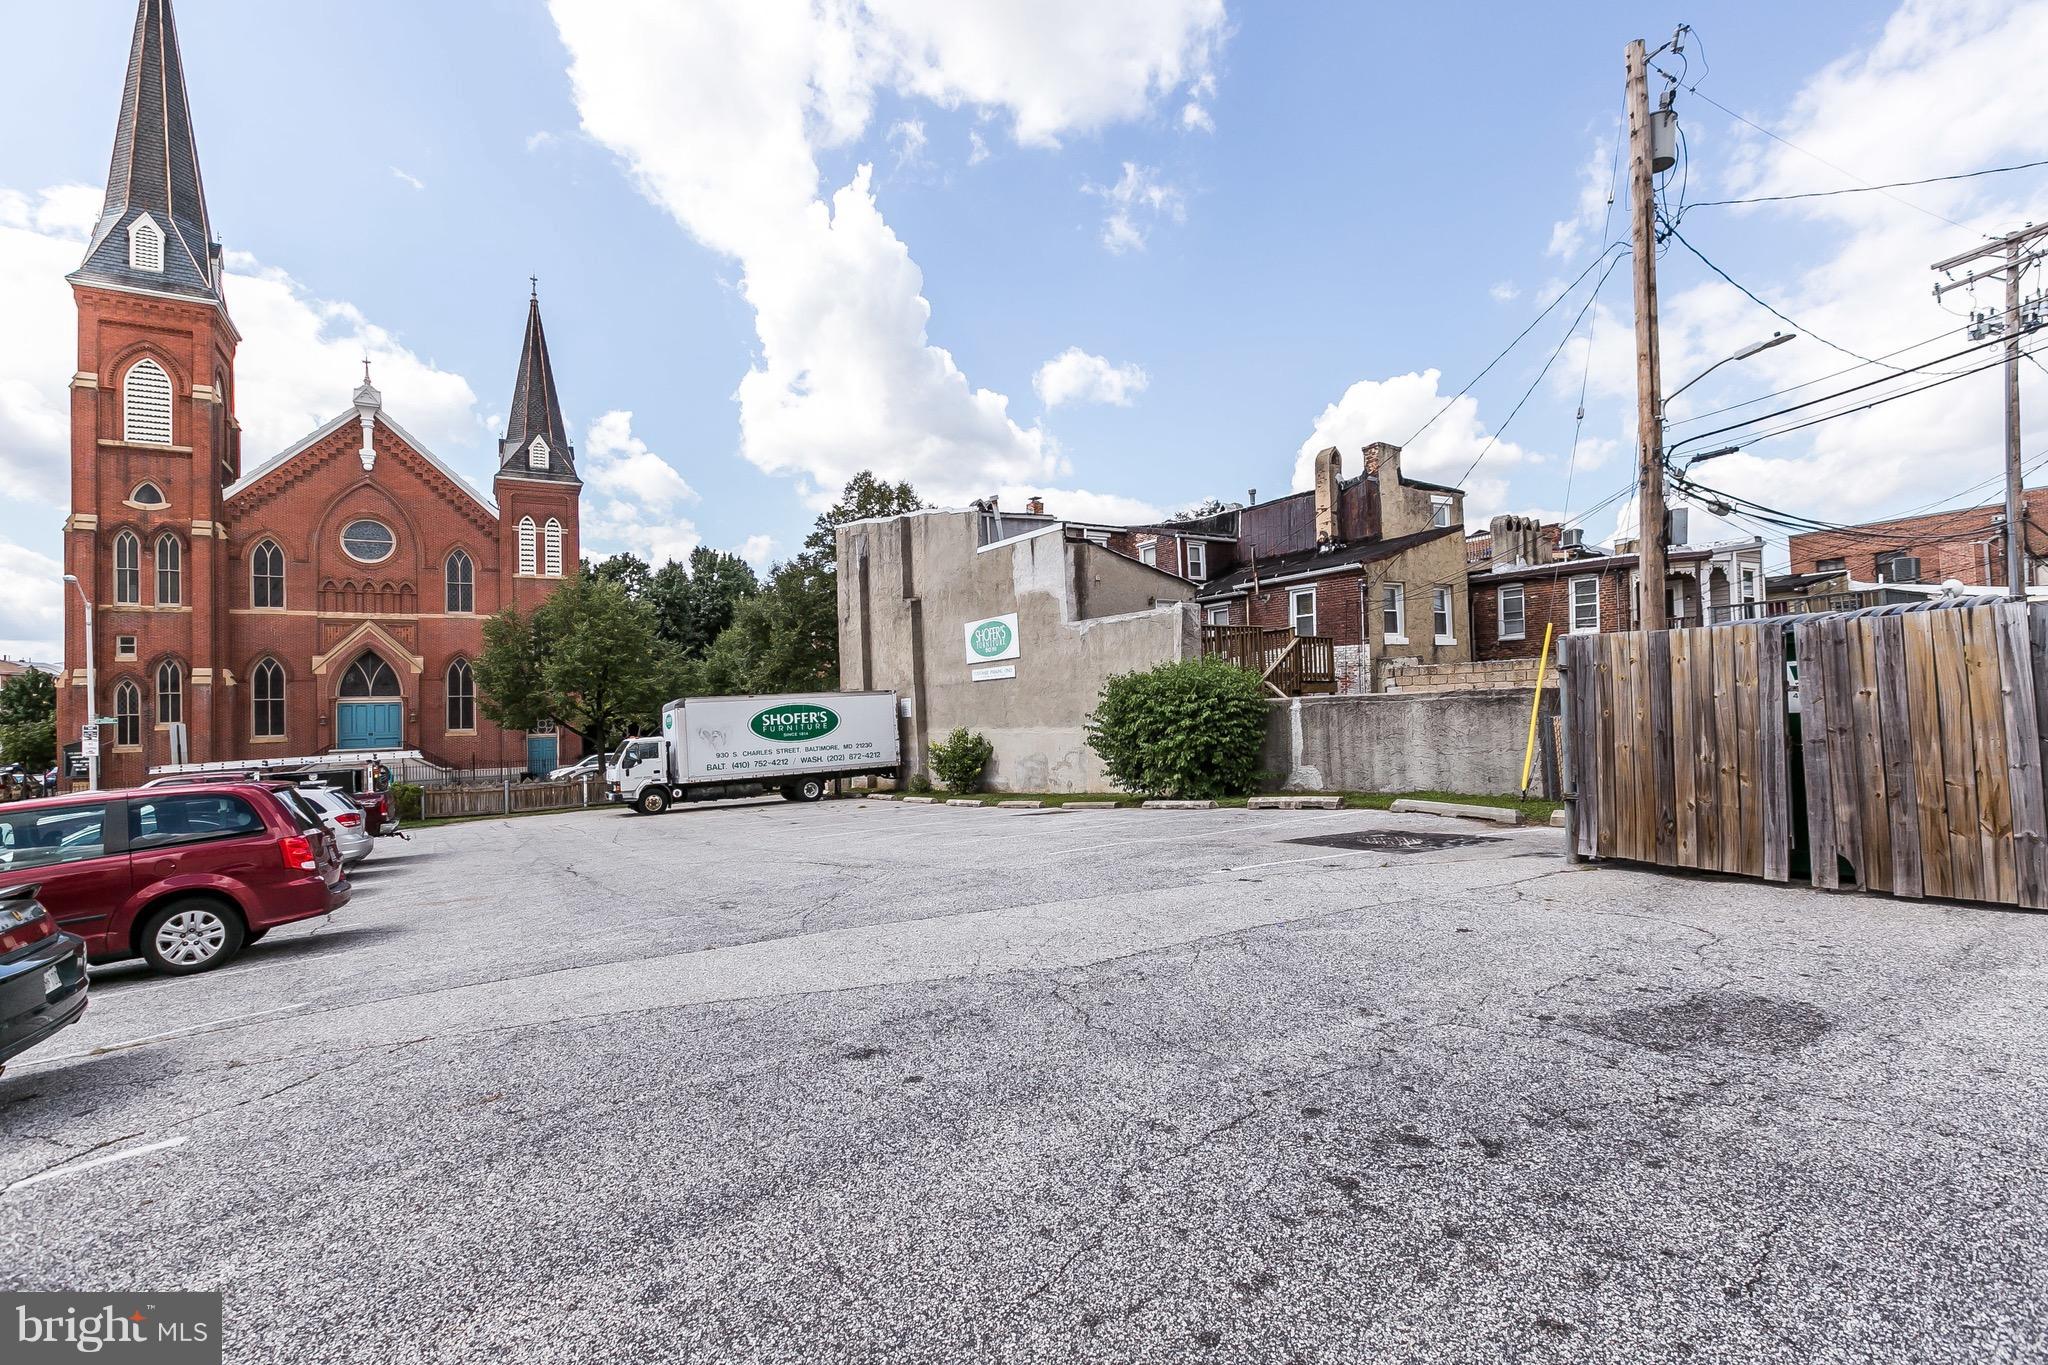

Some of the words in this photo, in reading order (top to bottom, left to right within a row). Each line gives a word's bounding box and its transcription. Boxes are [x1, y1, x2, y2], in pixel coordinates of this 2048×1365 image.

[762, 711, 828, 726] SHOFER'S
[763, 723, 828, 732] FURNITURE
[742, 749, 773, 757] CHARLES
[706, 763, 727, 771] BALT.
[732, 761, 750, 770] (410)
[754, 758, 789, 768] 752-4212
[827, 754, 845, 762] (202)
[849, 751, 881, 761] 872-4212
